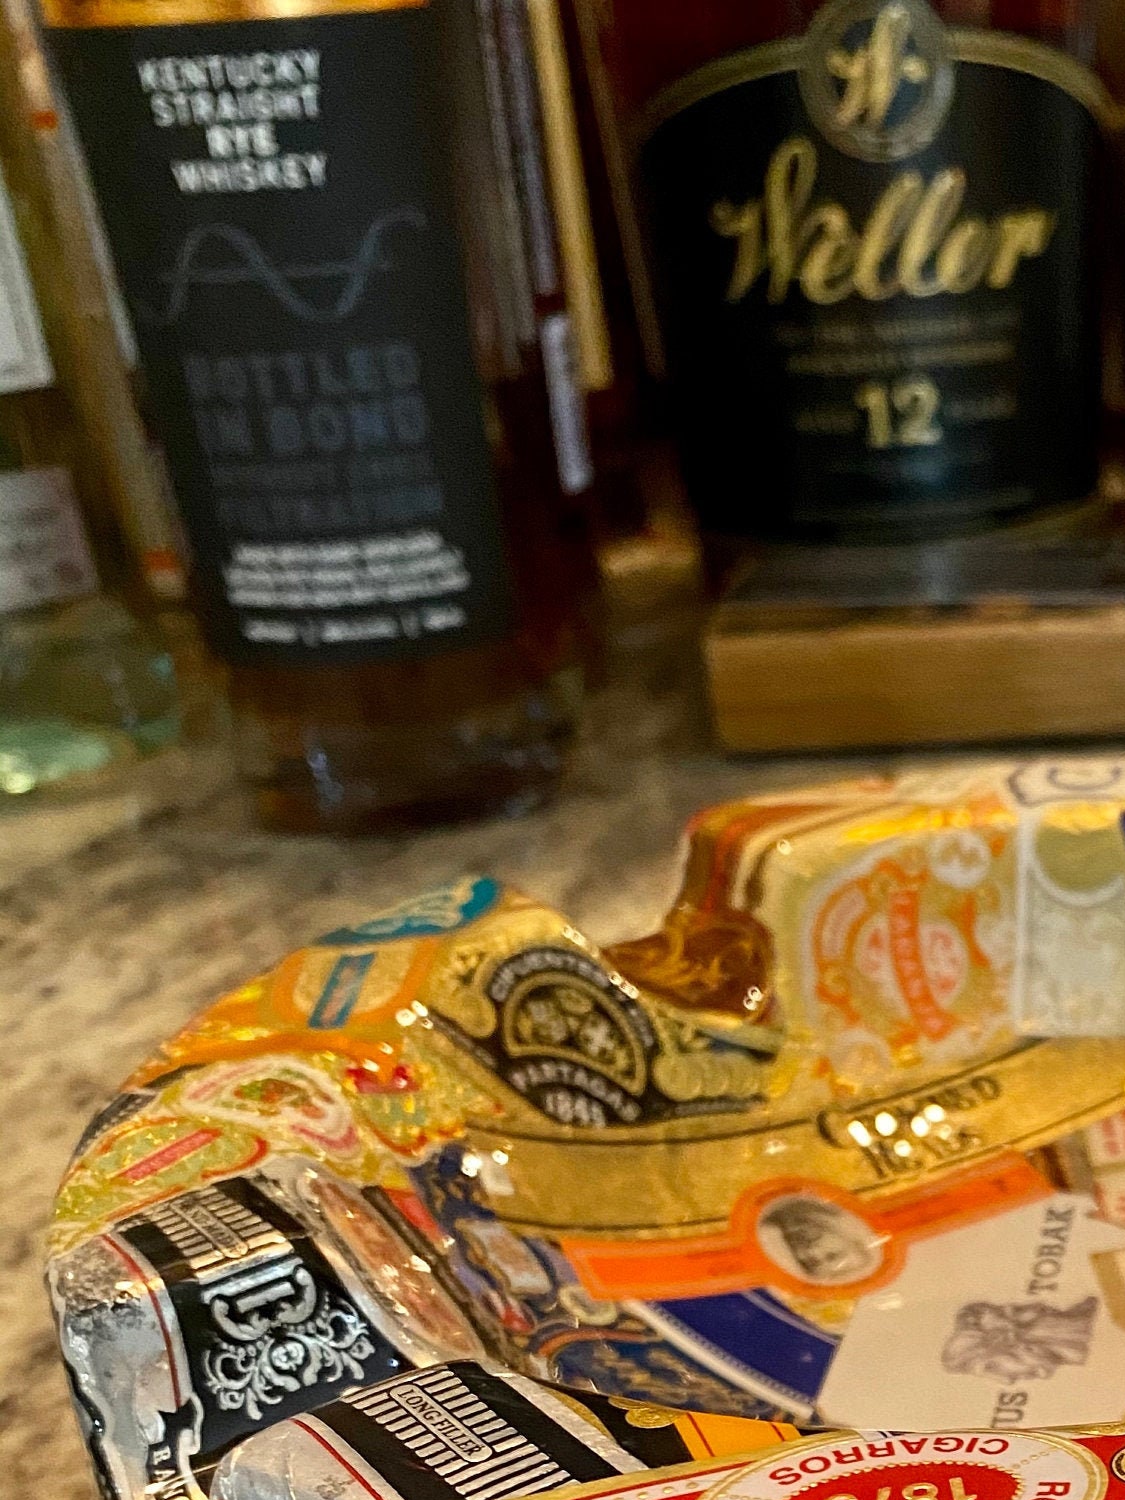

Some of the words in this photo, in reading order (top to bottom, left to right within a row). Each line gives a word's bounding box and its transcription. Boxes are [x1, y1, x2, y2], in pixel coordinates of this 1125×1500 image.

[138, 50, 320, 92] KENTUCKY
[150, 84, 320, 127] STRAIGHT
[171, 153, 327, 192] WHISKEY
[708, 137, 1056, 303] Weller
[856, 374, 942, 448] 12
[1026, 1206, 1075, 1296] TOBAK
[397, 1389, 442, 1420] LONG
[431, 1417, 486, 1456] FILLER
[768, 1436, 1010, 1486] CIGARROS
